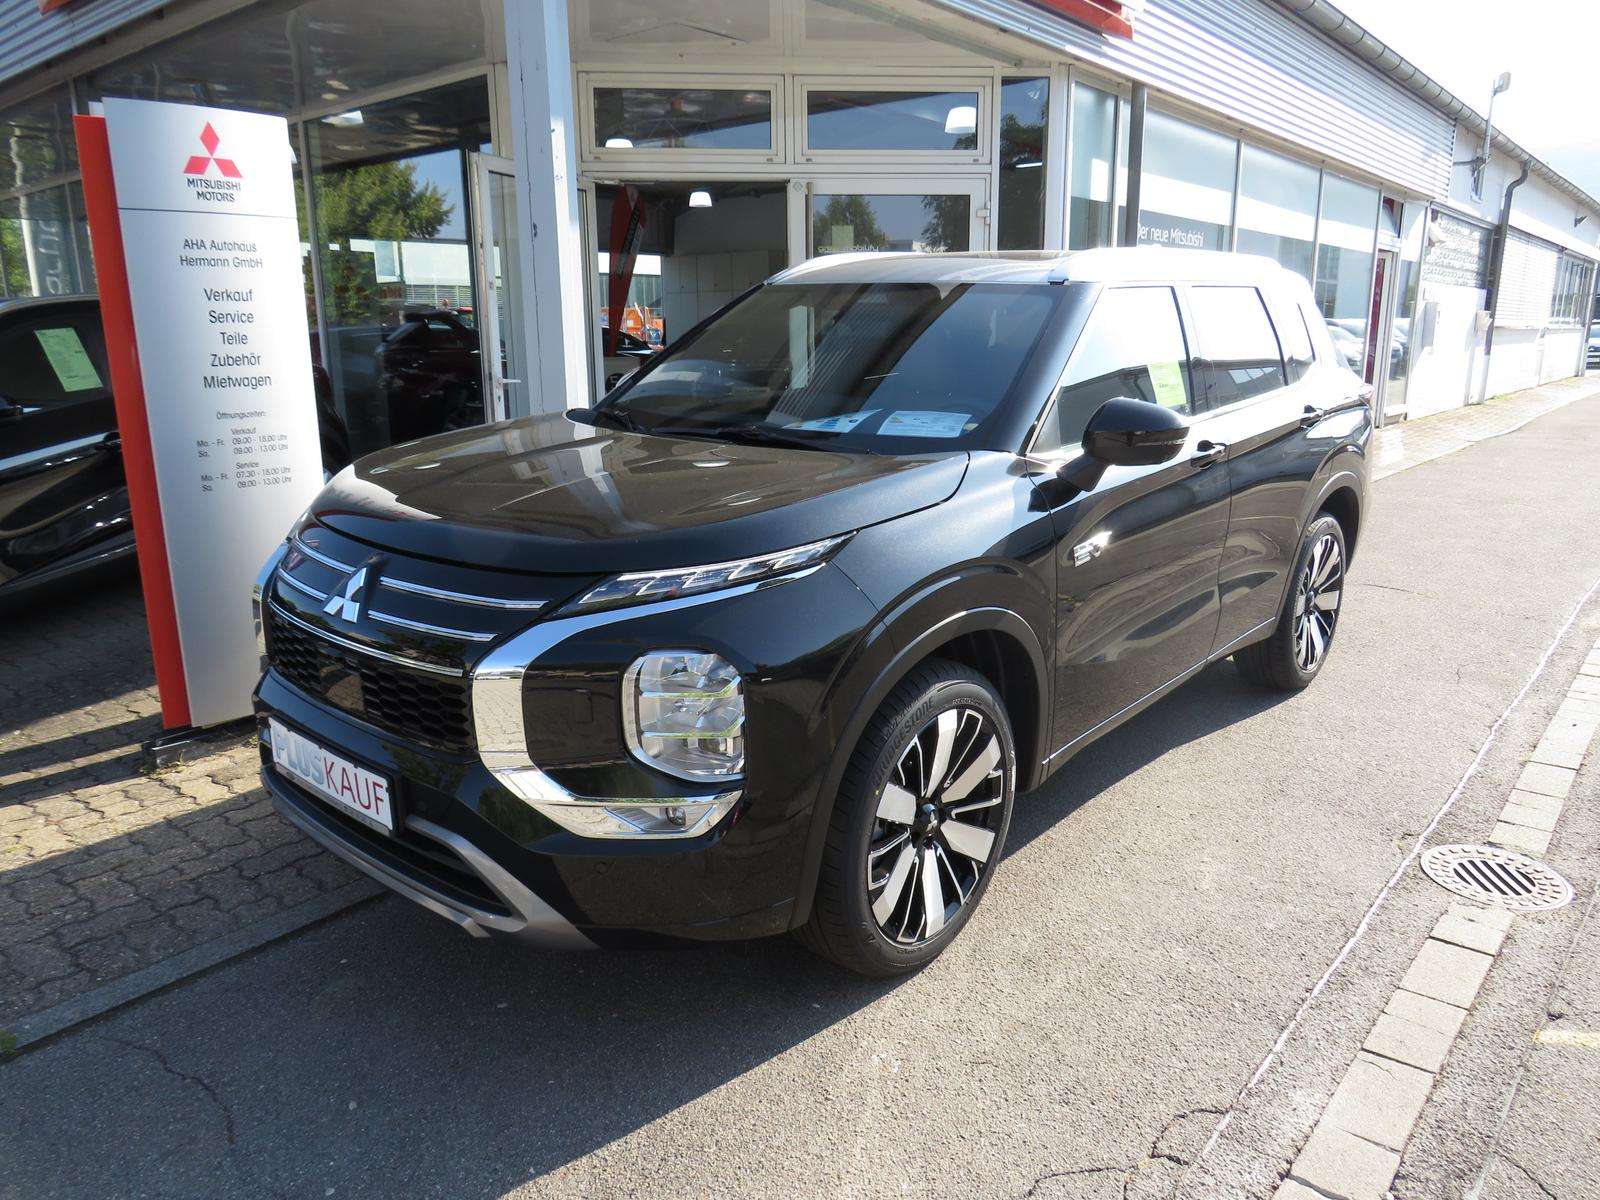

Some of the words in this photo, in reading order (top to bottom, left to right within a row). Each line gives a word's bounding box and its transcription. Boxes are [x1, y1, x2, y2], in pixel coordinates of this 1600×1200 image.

[186, 177, 242, 191] MITSUBISHI
[196, 190, 235, 202] MOTORS
[1150, 227, 1169, 242] neue
[1169, 228, 1205, 247] Mitsubishi
[183, 239, 207, 250] AHA
[209, 240, 258, 253] Autohaus
[179, 255, 230, 267] Hermann
[232, 257, 263, 269] GmbH
[203, 288, 254, 302] Verkauf
[208, 309, 255, 324] Service
[219, 331, 248, 345] Teile
[210, 352, 262, 367] Zubehör
[203, 375, 273, 390] Mietwagen
[230, 427, 257, 435] Verkauf
[235, 461, 260, 470] Service
